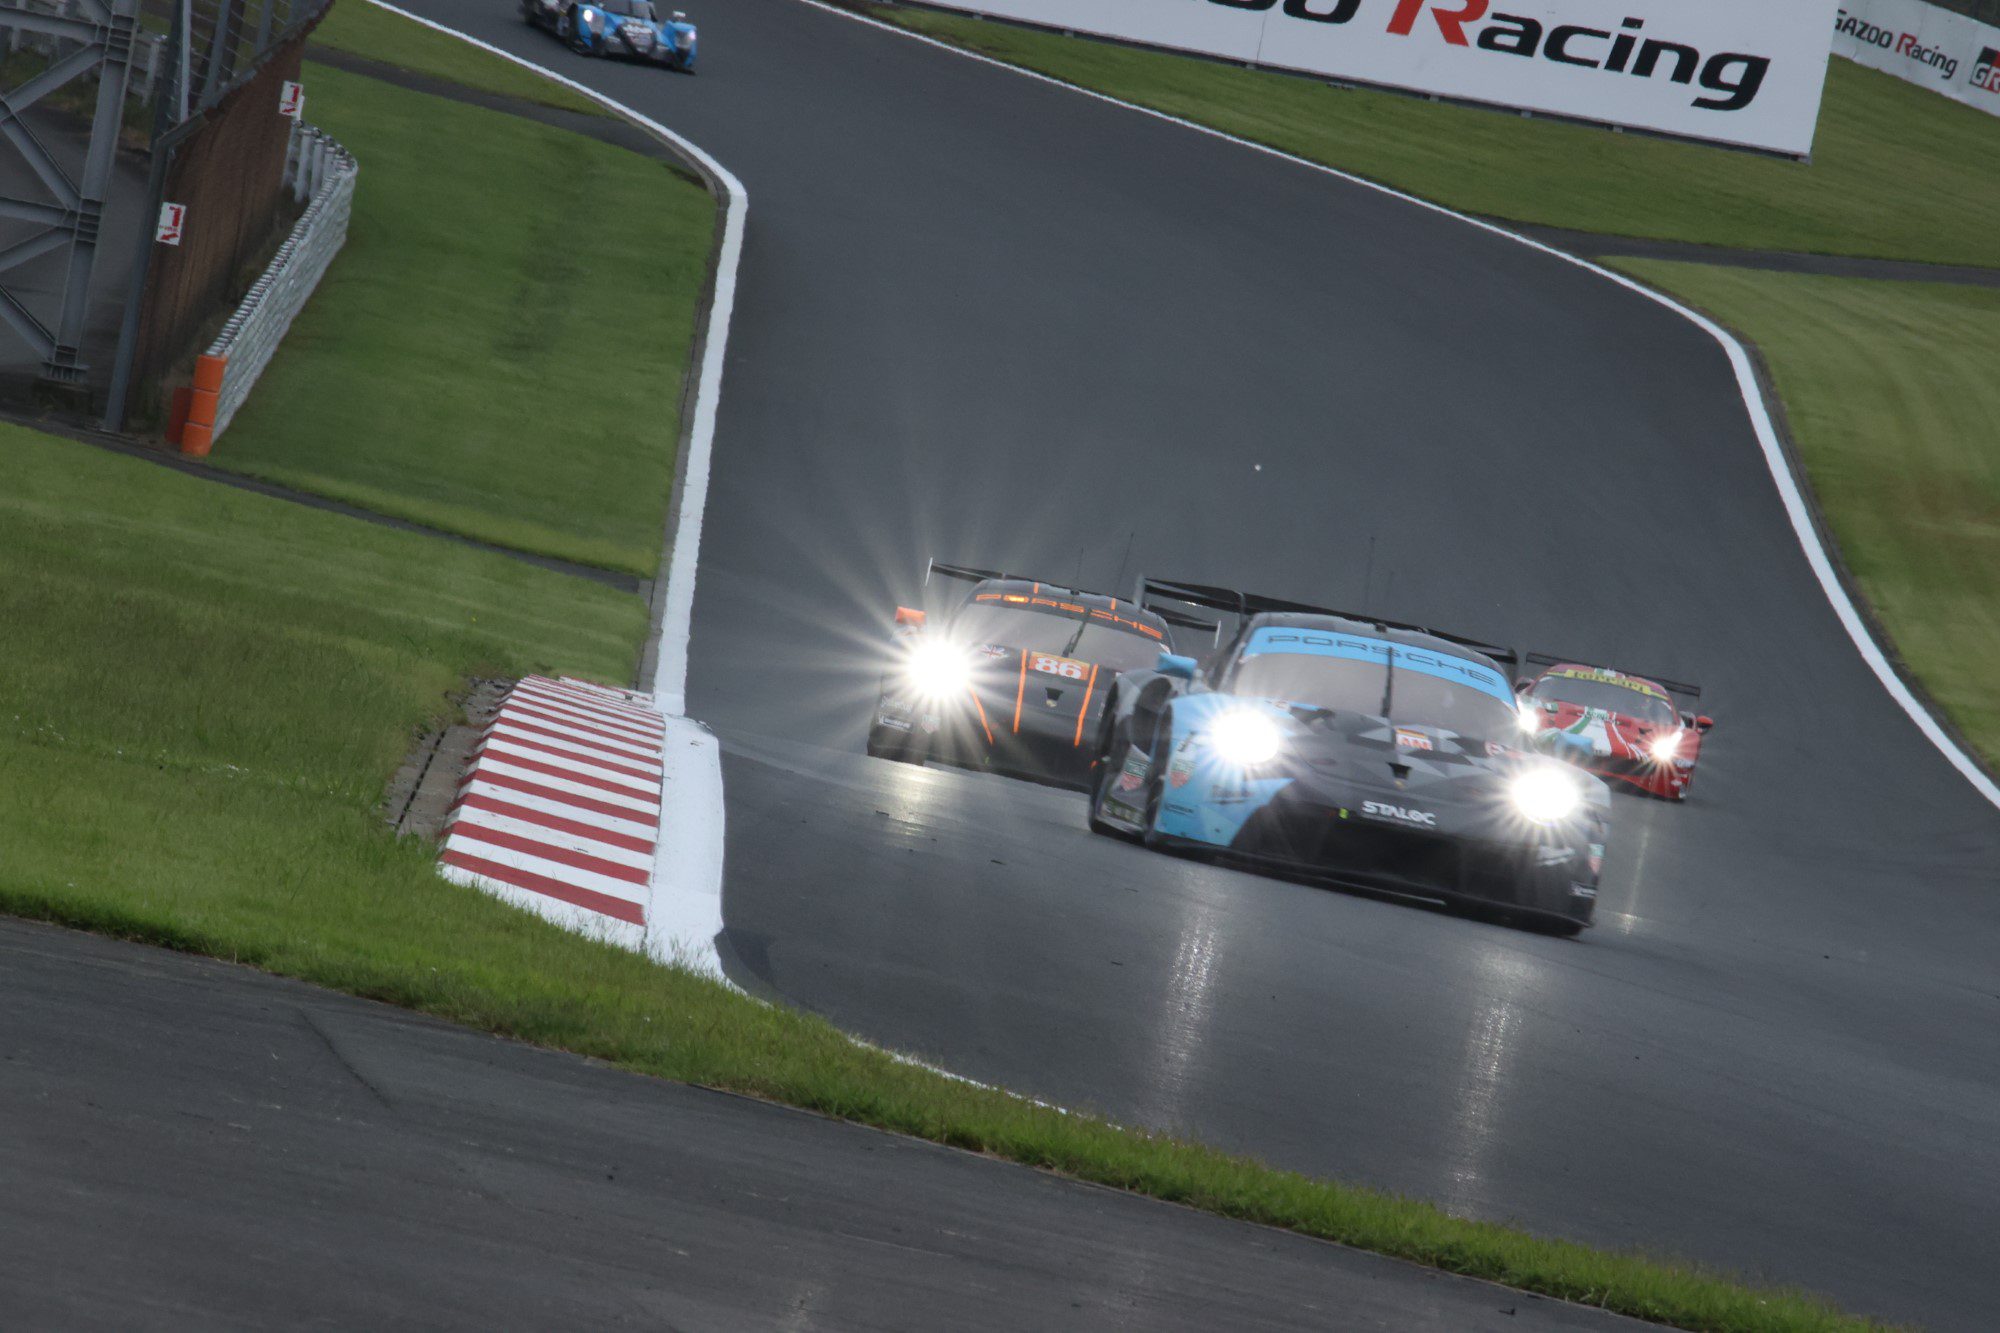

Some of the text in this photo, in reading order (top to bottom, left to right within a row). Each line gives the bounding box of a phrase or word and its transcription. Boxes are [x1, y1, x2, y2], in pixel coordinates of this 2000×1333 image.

[1386, 0, 1771, 111] Racing
[1896, 33, 1958, 80] Racing
[1034, 656, 1083, 681] 86
[1267, 634, 1497, 687] PORSCHE
